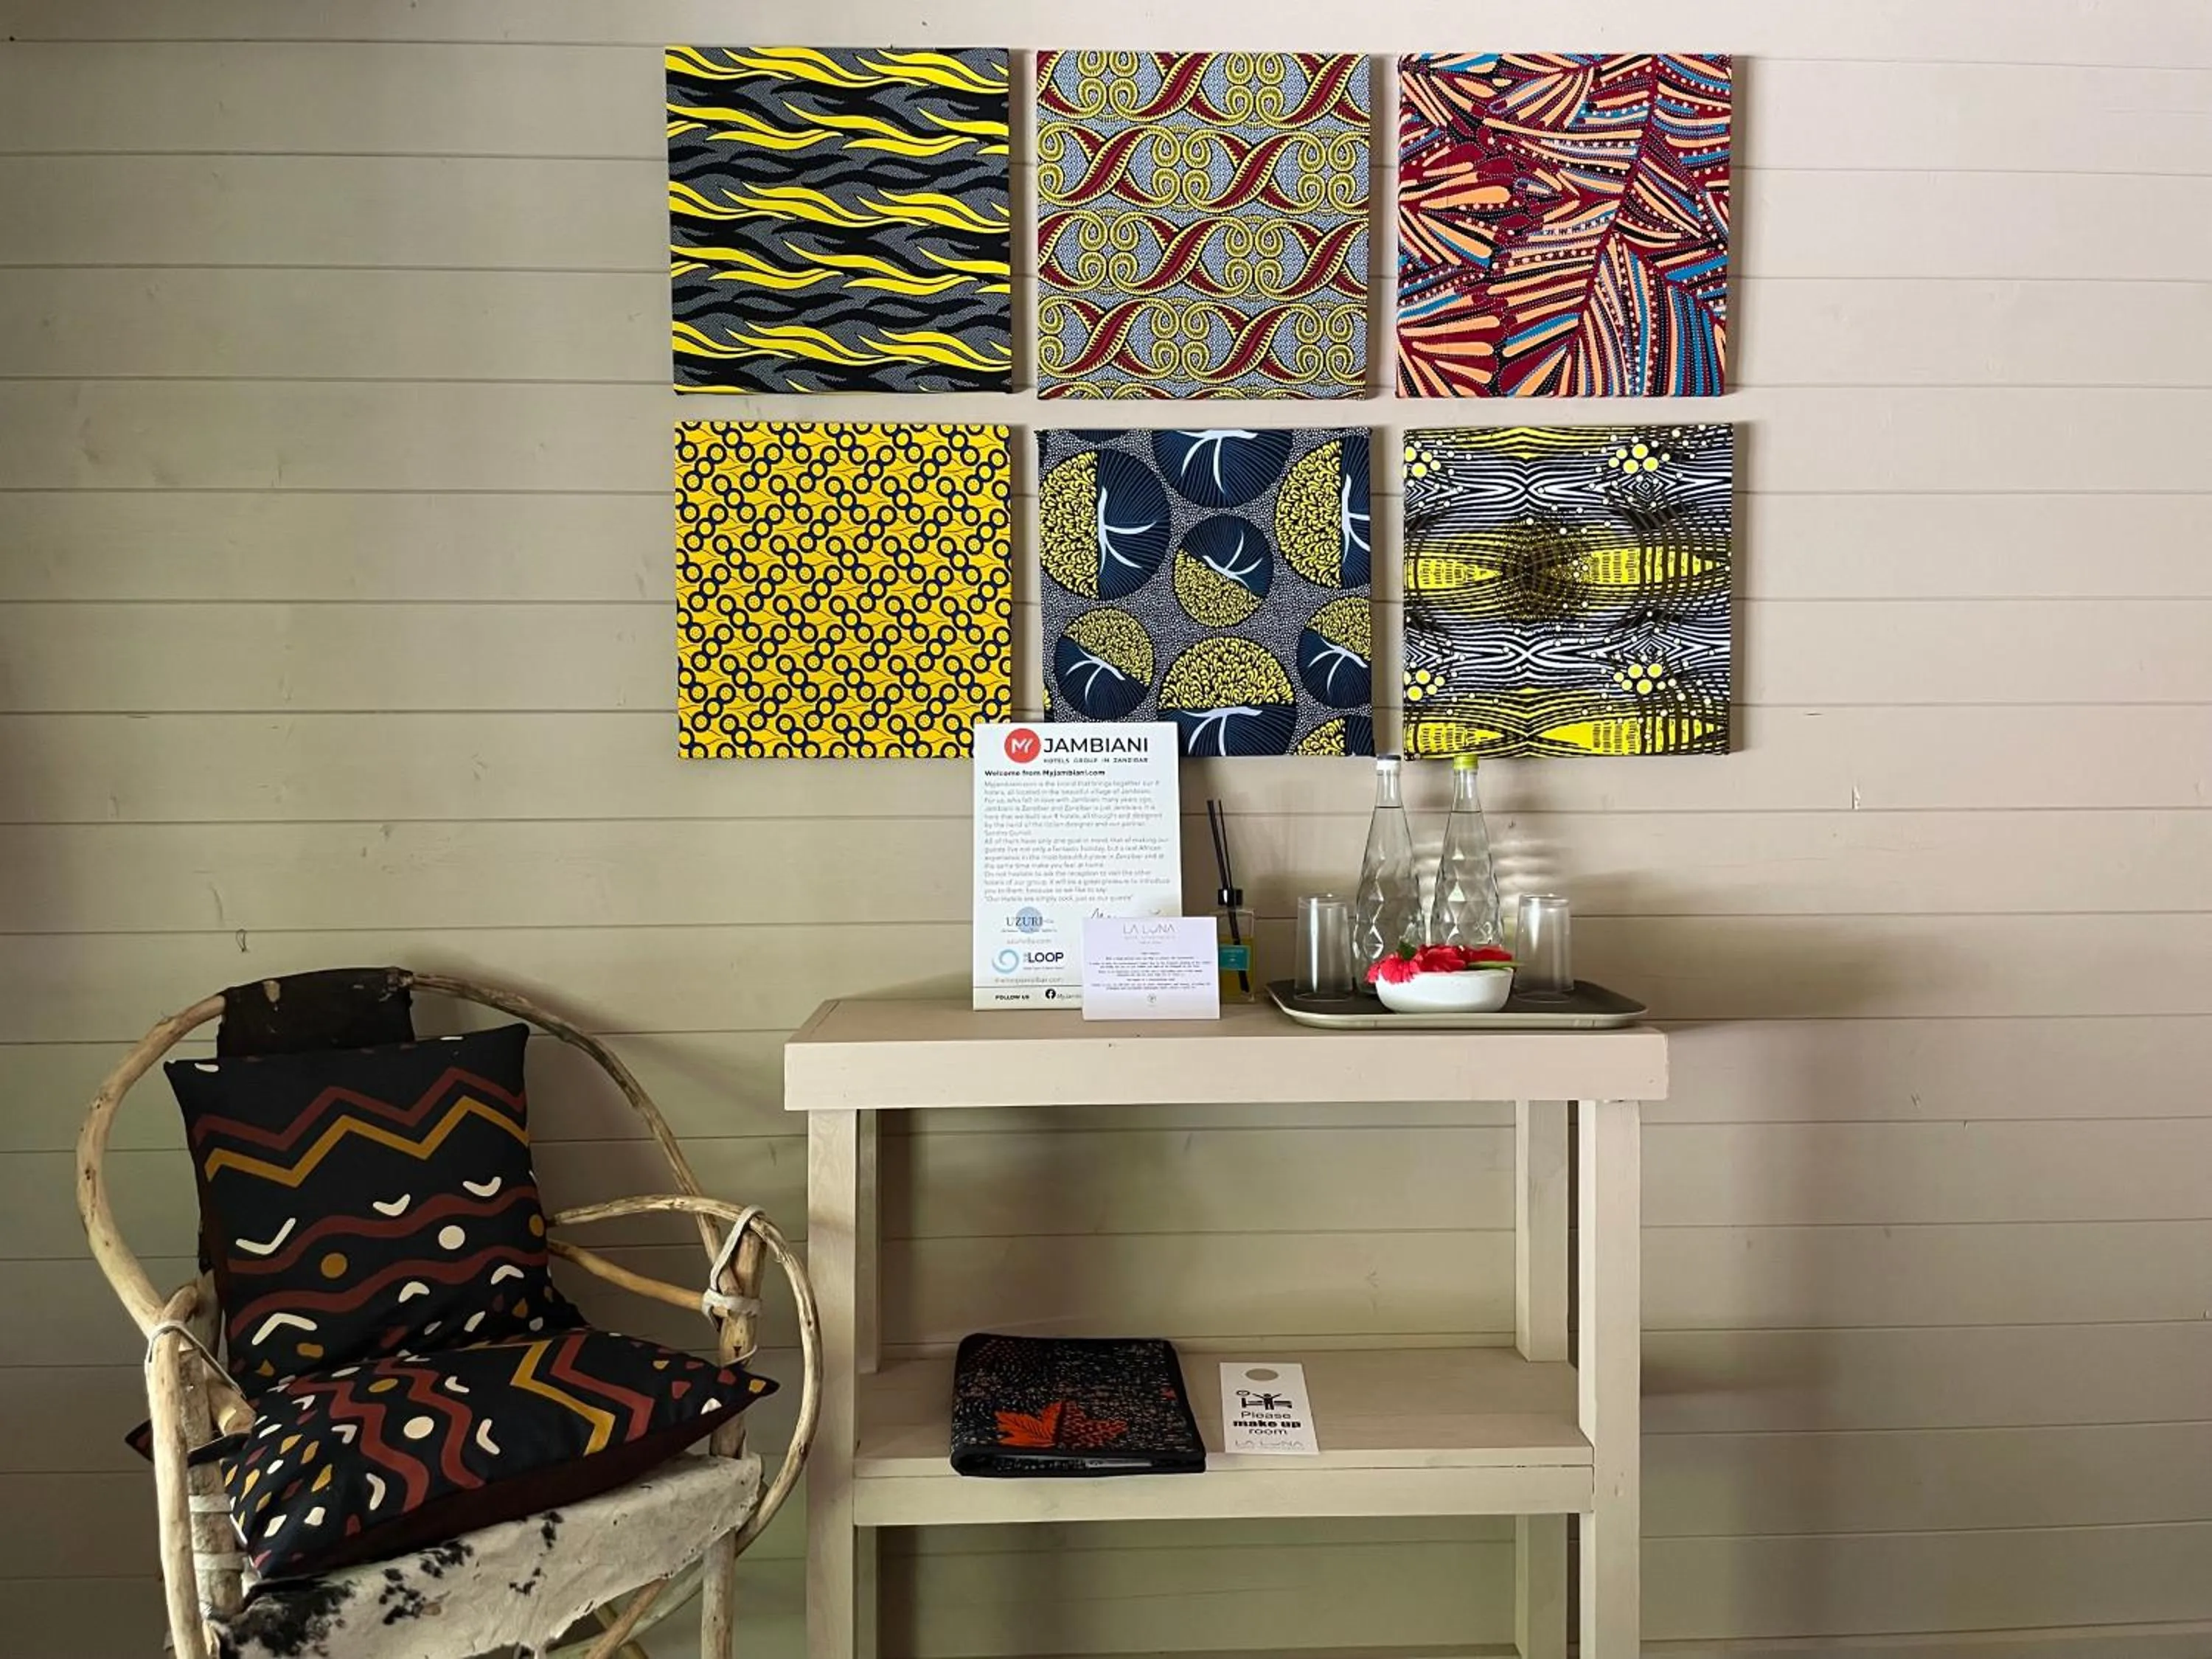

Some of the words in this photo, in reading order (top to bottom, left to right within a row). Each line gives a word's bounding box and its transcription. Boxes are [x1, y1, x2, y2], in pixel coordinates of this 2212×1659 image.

[1043, 737, 1148, 753] JAMBIANI
[1043, 769, 1105, 777] Myjambiani.com
[1006, 917, 1043, 928] UZURI
[1123, 924, 1139, 934] LA
[1142, 923, 1175, 934] LUNA
[1028, 953, 1065, 964] LOOP
[1241, 1411, 1291, 1419] Please
